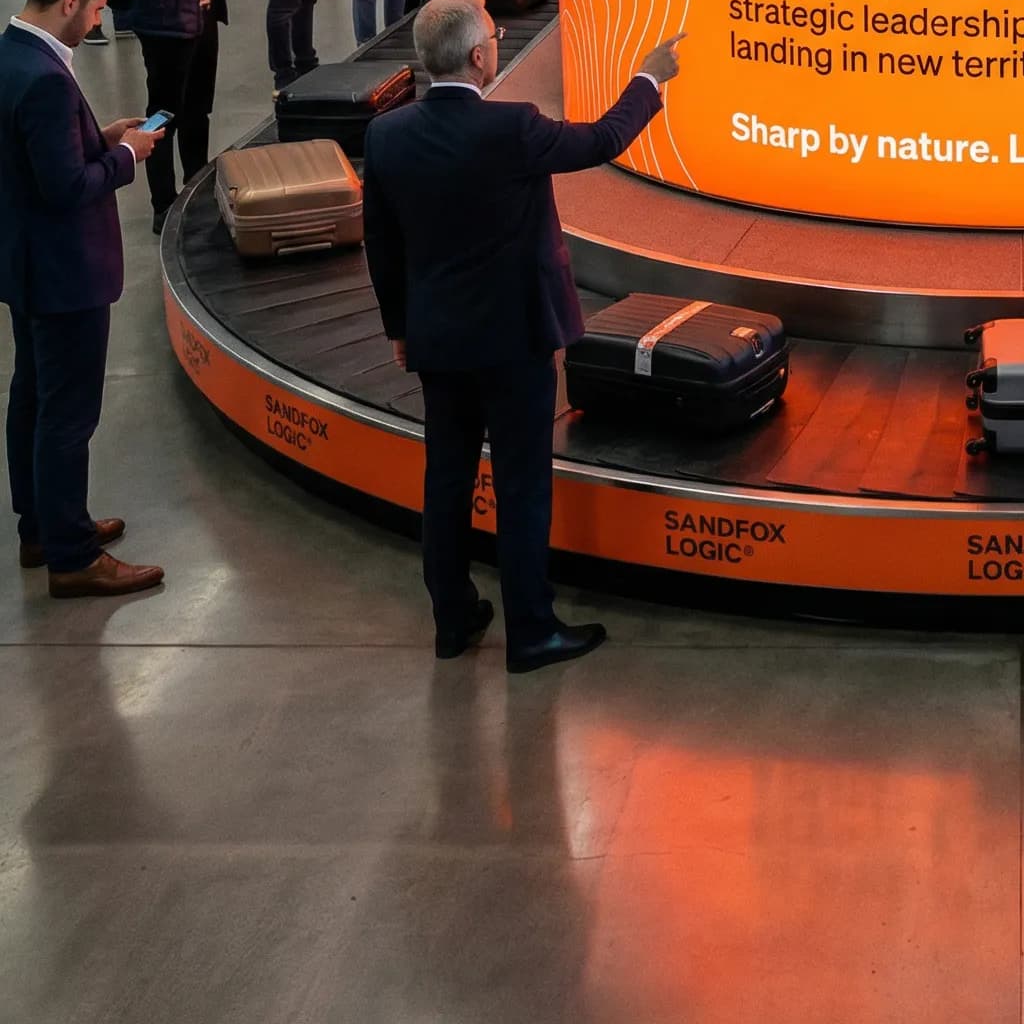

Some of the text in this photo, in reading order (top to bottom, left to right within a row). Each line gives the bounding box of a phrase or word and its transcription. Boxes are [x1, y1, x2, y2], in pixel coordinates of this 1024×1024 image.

[730, 30, 832, 76] landing
[843, 43, 868, 73] in
[878, 53, 944, 77] new
[731, 112, 821, 158] Sharp
[829, 124, 869, 164] by
[877, 132, 999, 164] nature.
[265, 394, 329, 441] SANDFOX
[664, 510, 787, 543] SANDFOX
